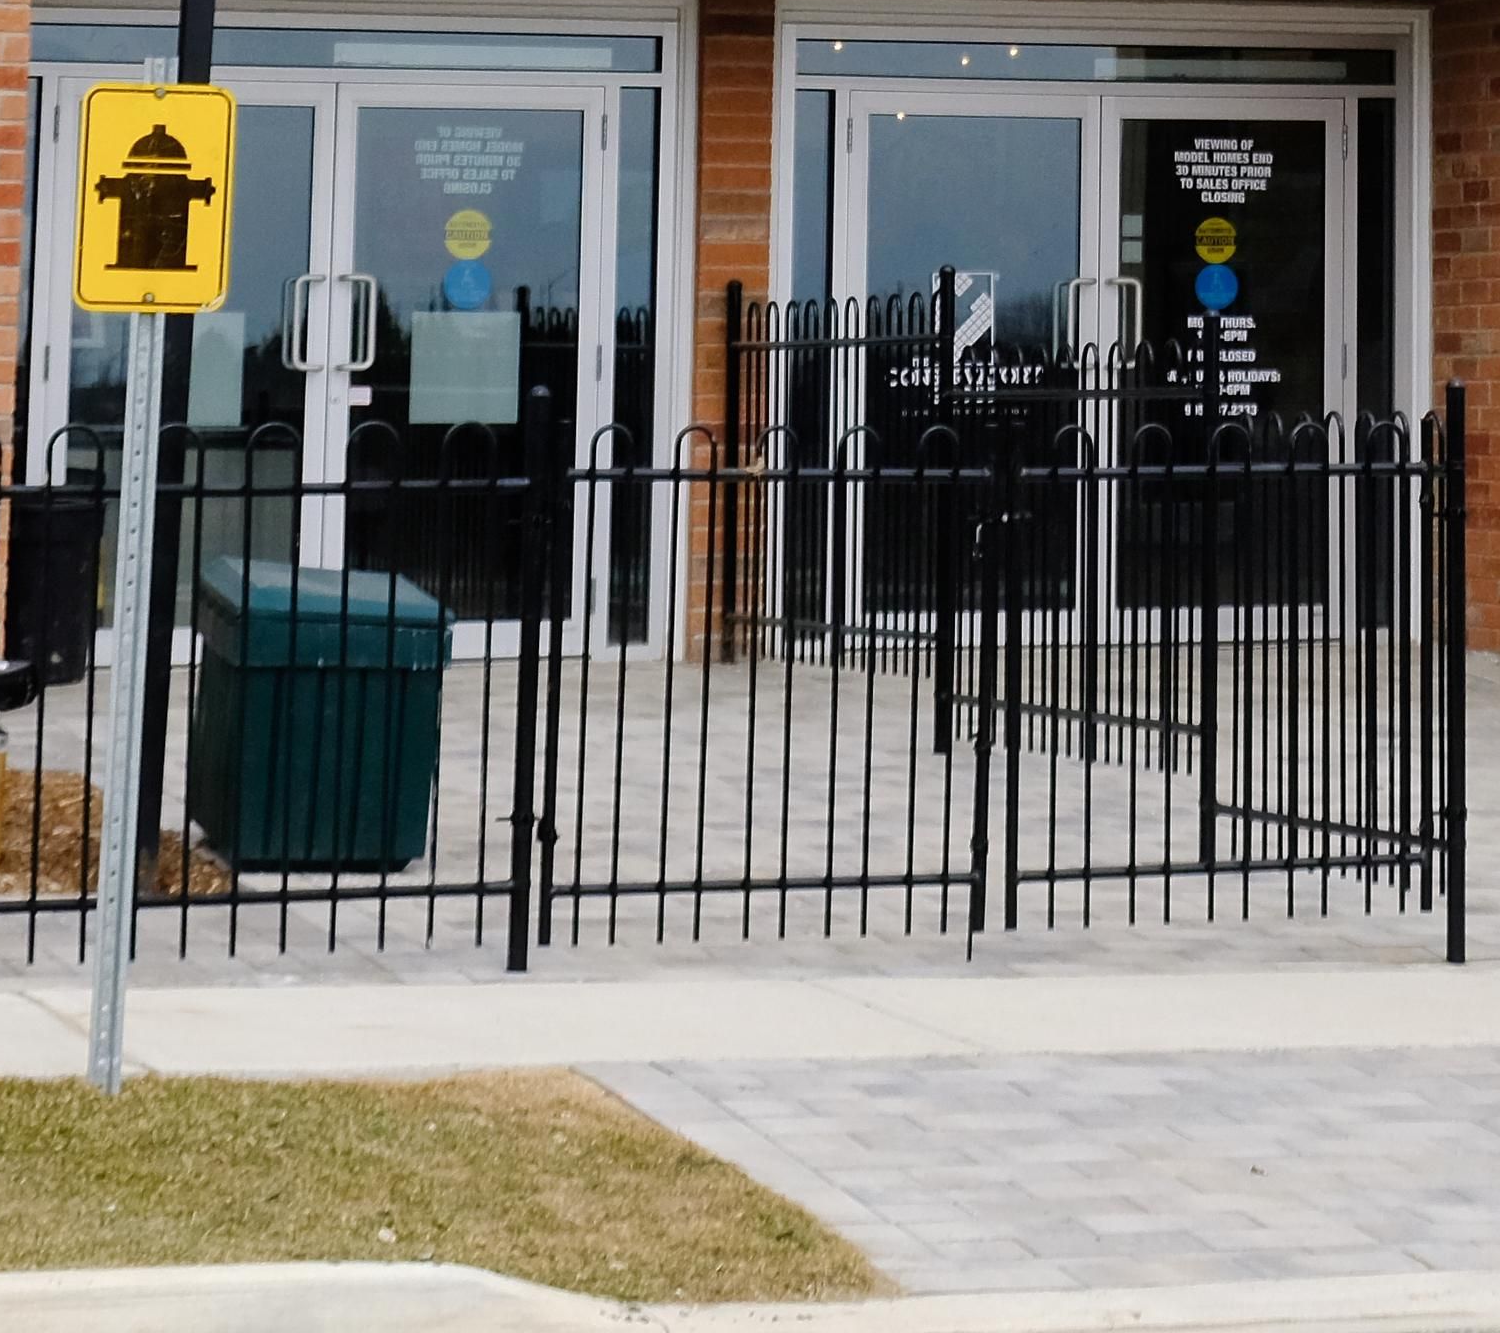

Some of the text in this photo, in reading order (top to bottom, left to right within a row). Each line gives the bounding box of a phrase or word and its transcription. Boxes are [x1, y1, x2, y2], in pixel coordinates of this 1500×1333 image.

[1194, 138, 1254, 151] VIEWING OF
[1174, 151, 1273, 164] MODEL HOMES END
[1175, 165, 1272, 178] 30 MINUTES PRIOR
[1180, 178, 1267, 191] TO SALES OFFICE
[1201, 192, 1245, 203] CLOSING
